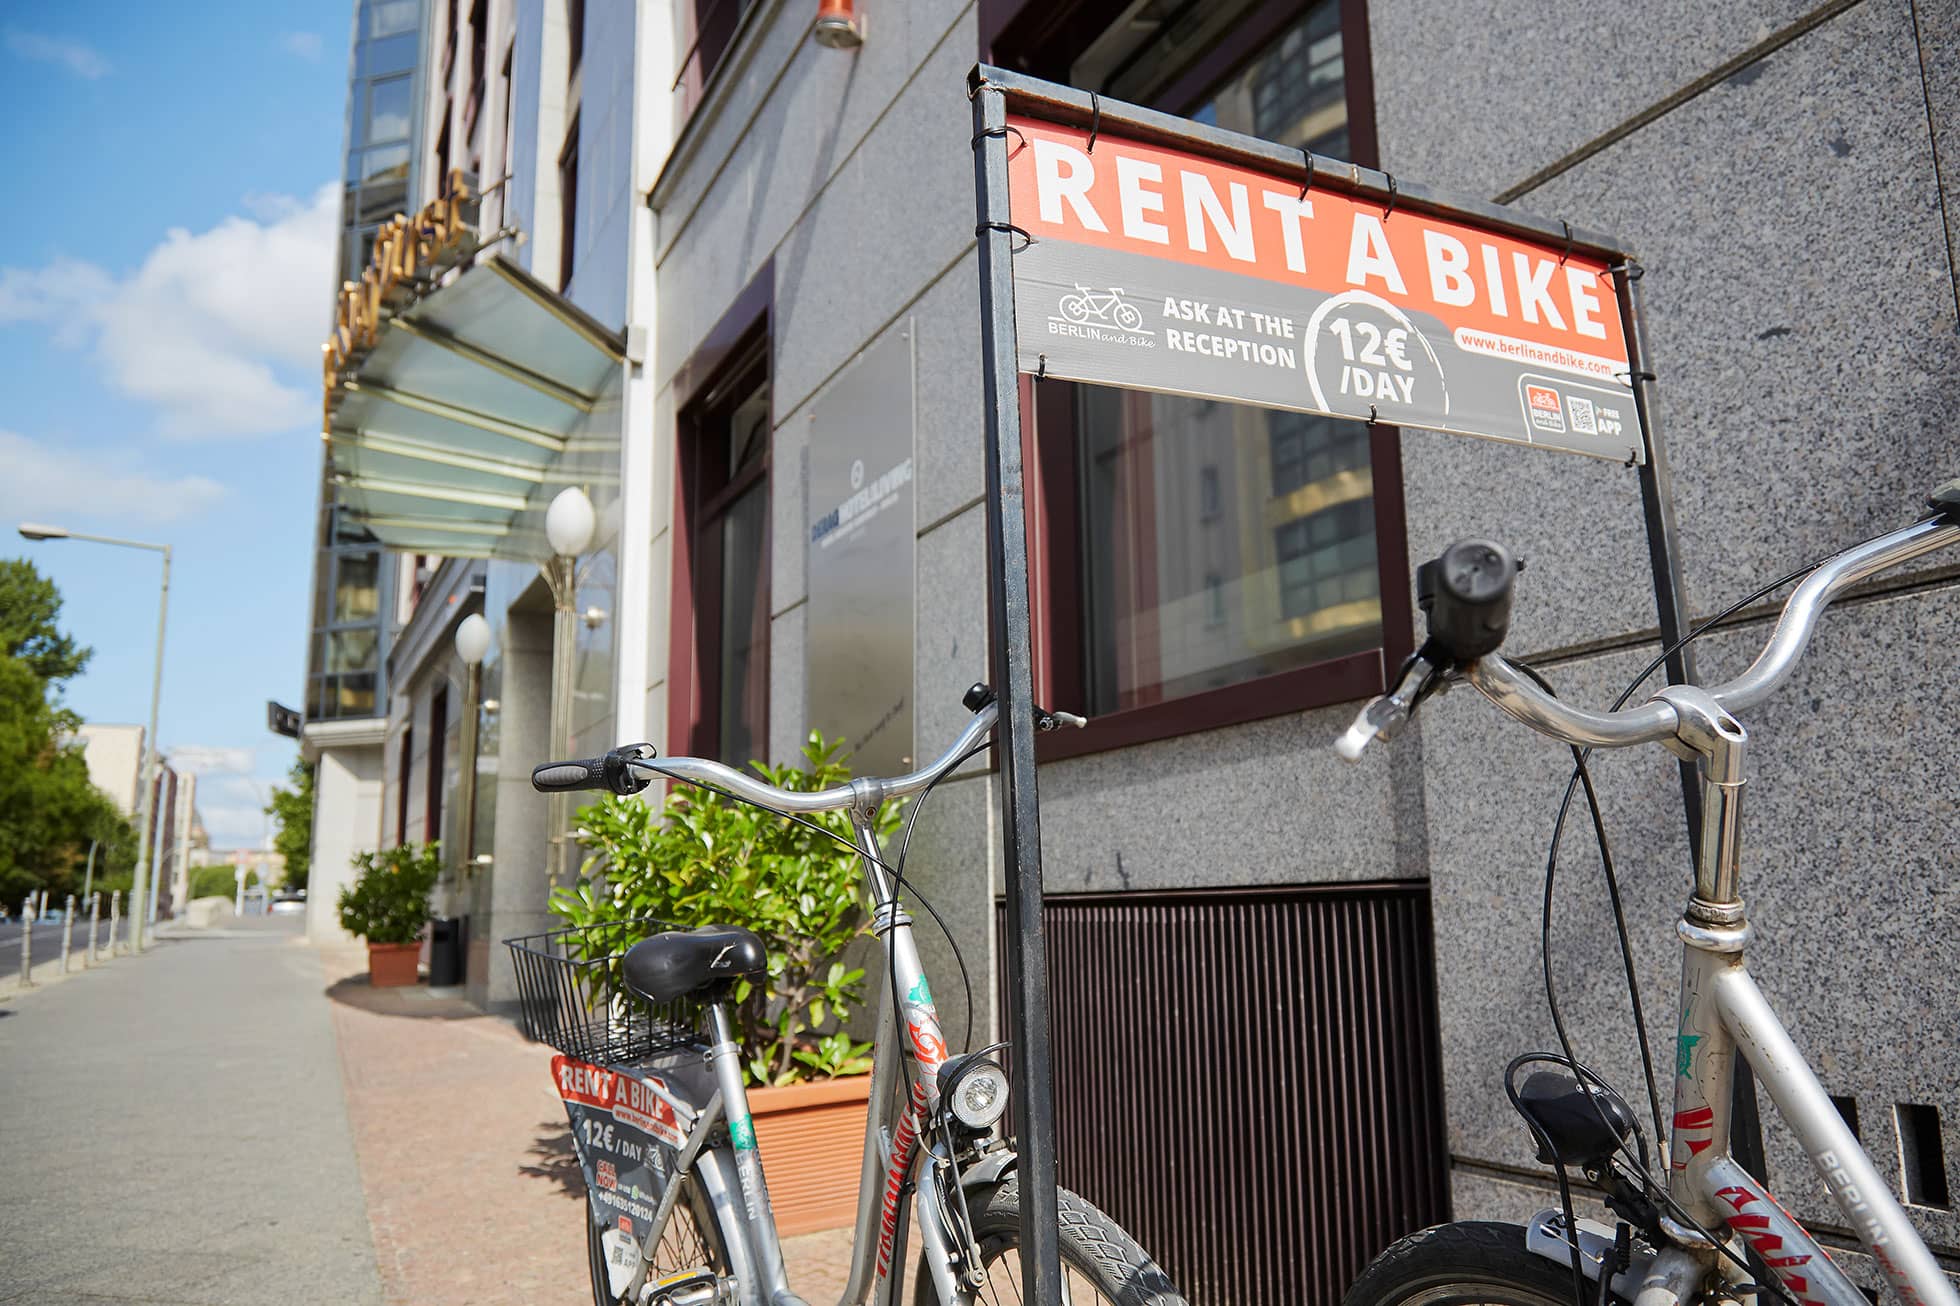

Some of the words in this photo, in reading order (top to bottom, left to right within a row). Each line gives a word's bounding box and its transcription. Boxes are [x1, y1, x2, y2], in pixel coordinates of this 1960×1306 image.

[1033, 139, 1314, 274] RENT
[1346, 212, 1408, 295] A
[1423, 229, 1607, 340] BIKE
[1048, 322, 1100, 341] BERLIN
[1163, 297, 1211, 325] ASK
[1216, 306, 1246, 330] AT
[1250, 312, 1295, 339] THE
[1166, 328, 1297, 369] RECEPTION
[1329, 318, 1413, 371] 12€
[1461, 333, 1612, 375] www.berlinandbike.com
[1340, 365, 1415, 404] /DAY
[1598, 419, 1622, 436] APP
[560, 1064, 612, 1100] RENT
[615, 1078, 627, 1104] A
[631, 1081, 664, 1119] BIKE
[582, 1119, 615, 1153] 12€
[622, 1140, 642, 1161] DAY
[596, 1173, 618, 1192] NOW
